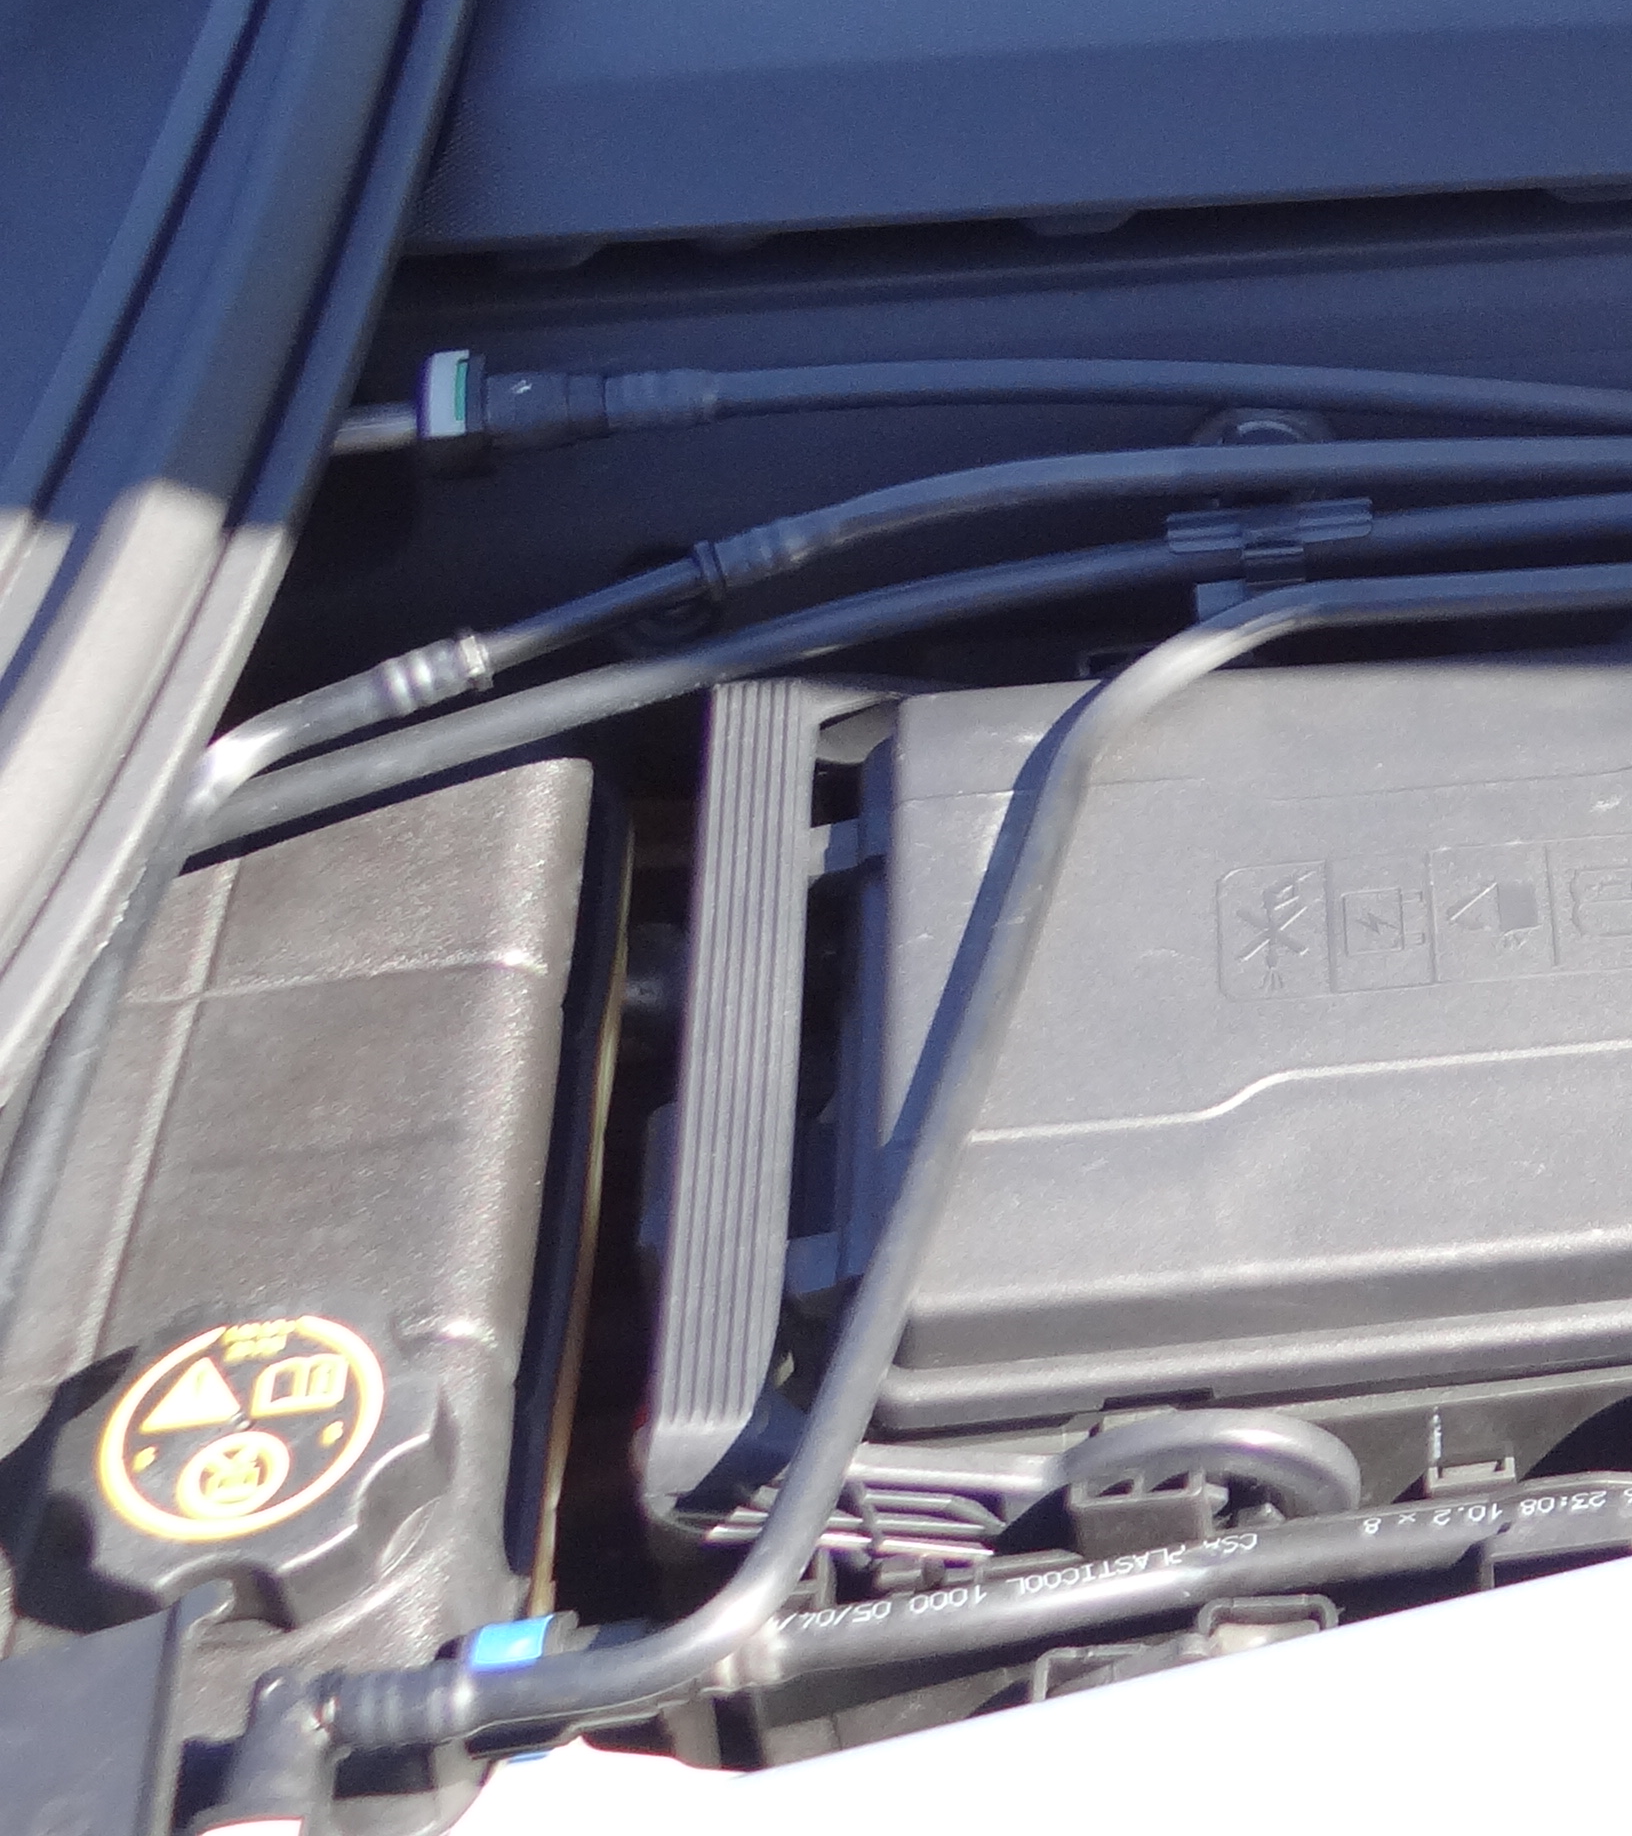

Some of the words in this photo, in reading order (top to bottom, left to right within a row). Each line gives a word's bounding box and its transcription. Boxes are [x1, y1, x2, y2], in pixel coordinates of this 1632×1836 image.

[1433, 1503, 1503, 1526] 10.2
[1519, 1490, 1607, 1516] 23:08
[1362, 1517, 1382, 1535] 8
[908, 1585, 988, 1614] 1000
